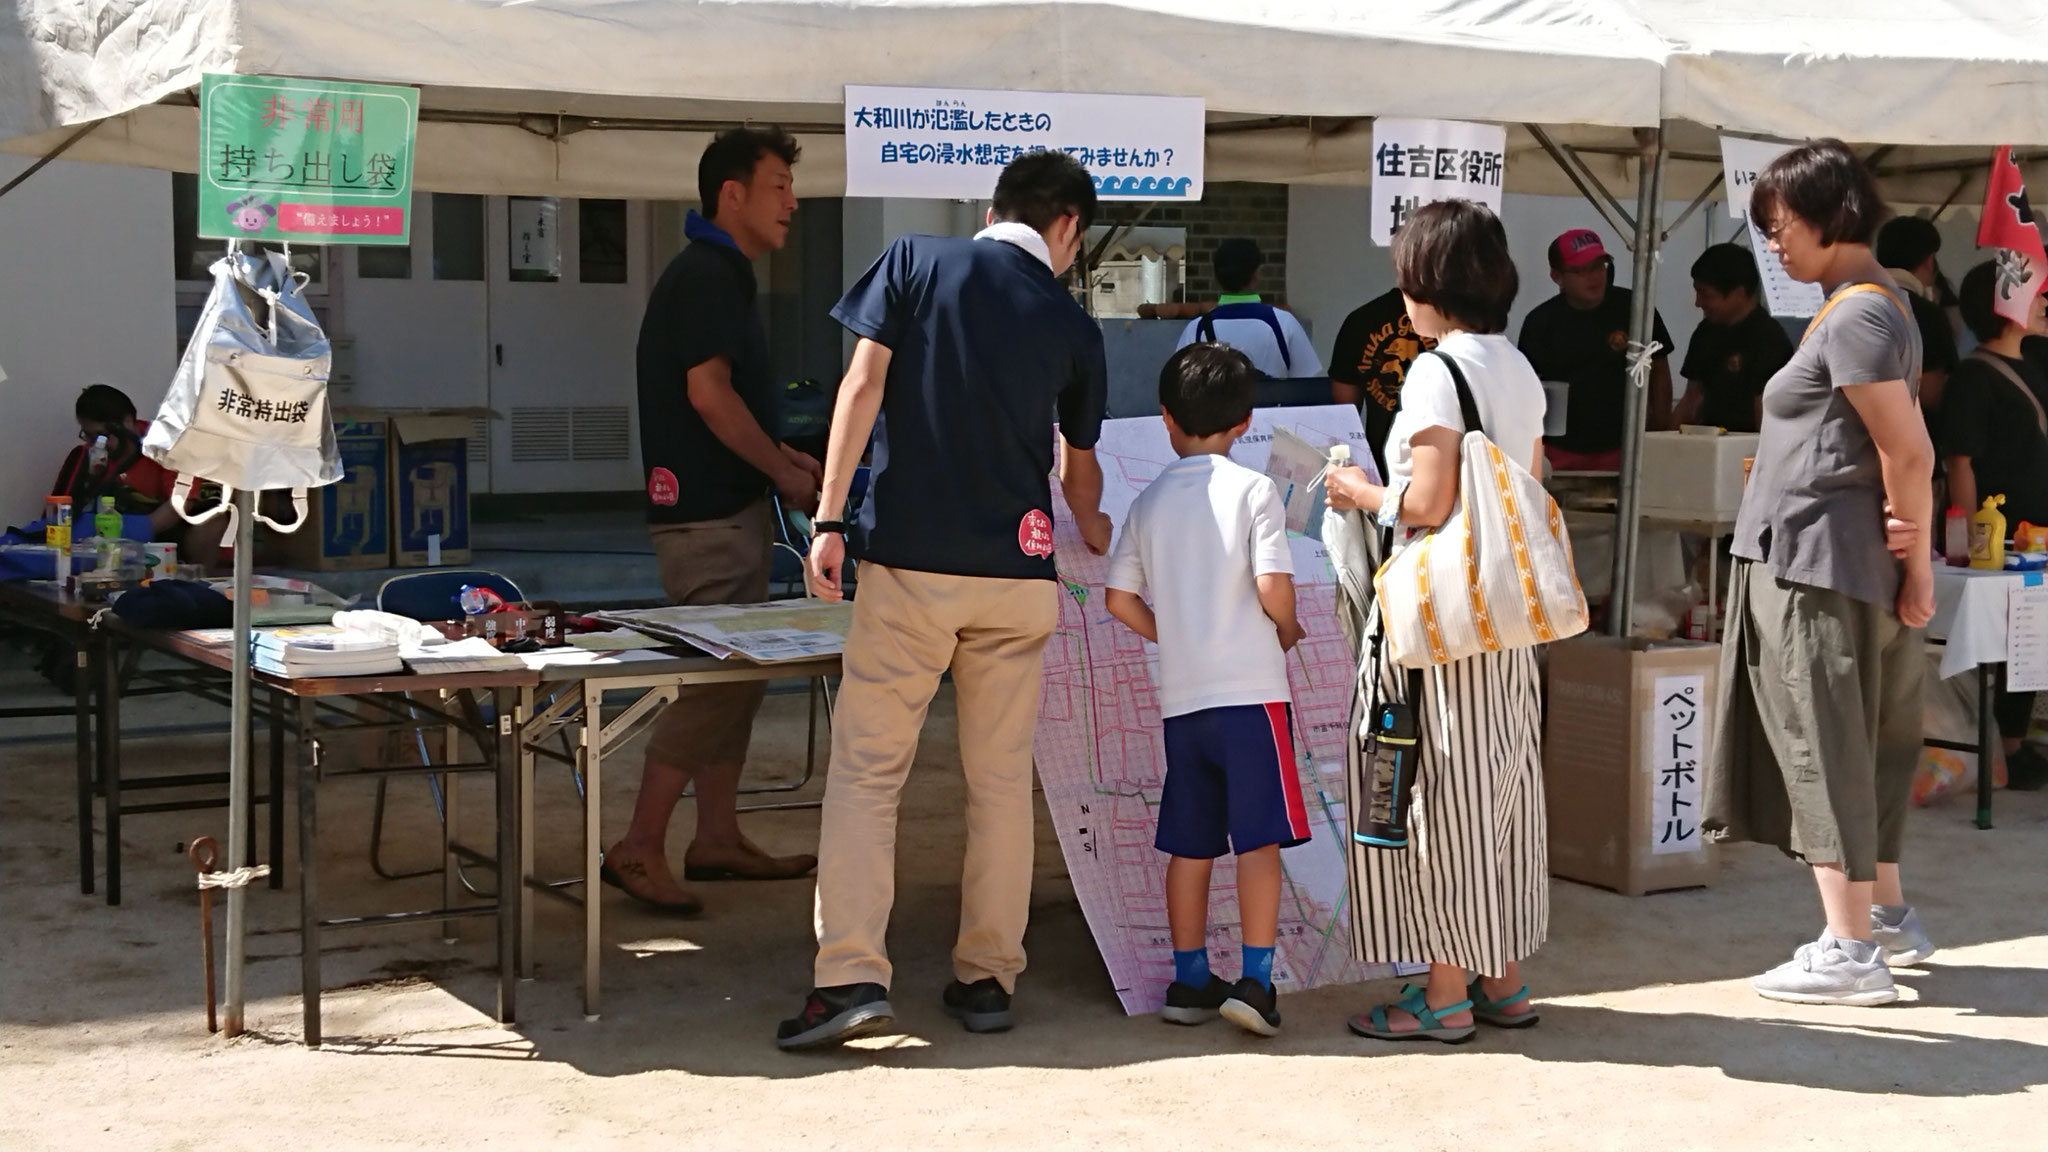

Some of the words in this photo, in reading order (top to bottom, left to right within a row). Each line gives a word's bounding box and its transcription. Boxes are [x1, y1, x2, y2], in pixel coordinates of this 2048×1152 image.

[260, 94, 363, 135] 非常用
[853, 106, 1051, 132] 大和川が氾濫したときの
[219, 144, 397, 187] 持ち出し袋
[881, 141, 1174, 168] 自宅の浸水想定をてみませんか？
[1376, 142, 1502, 187] 住吉区役所
[218, 388, 309, 423] 非常持出袋
[1660, 686, 1696, 844] ペットボトル
[1081, 804, 1090, 815] N
[1083, 842, 1092, 852] S
